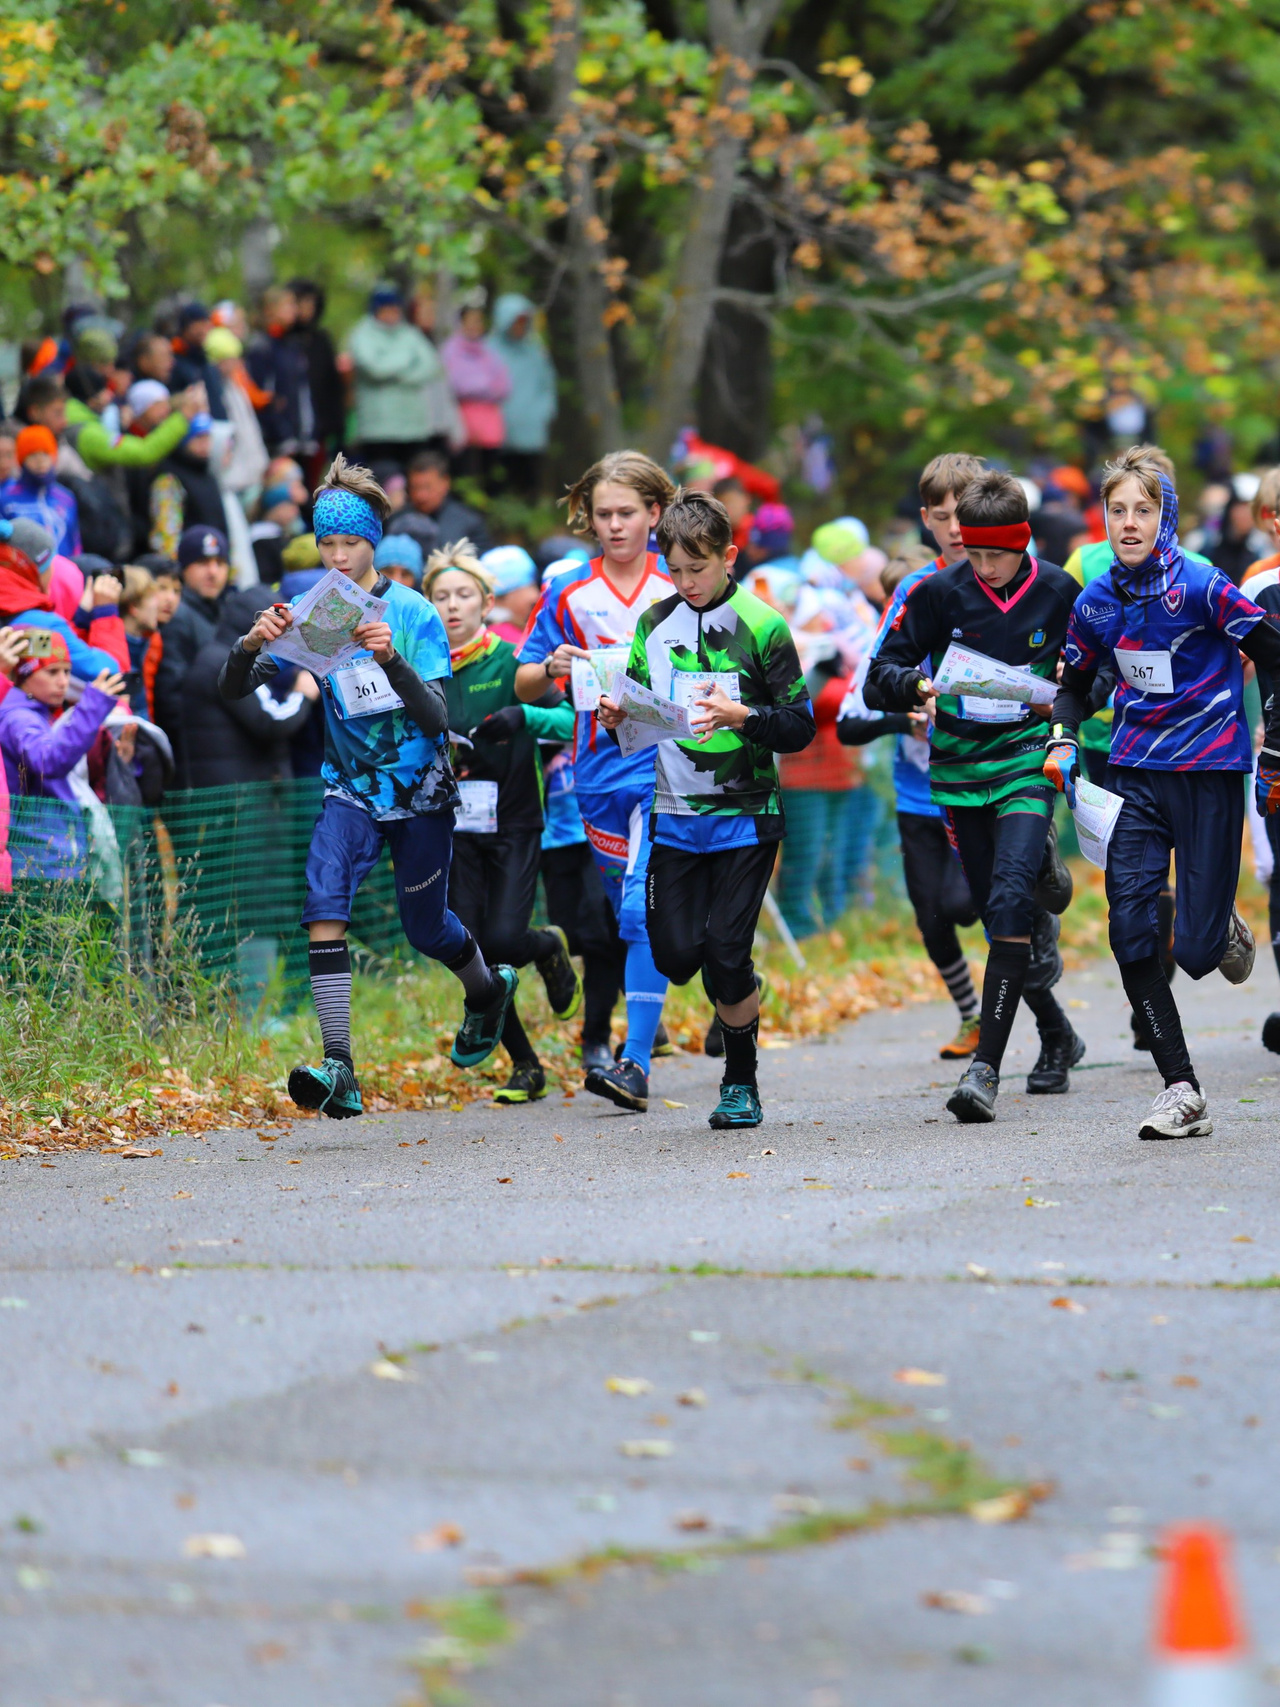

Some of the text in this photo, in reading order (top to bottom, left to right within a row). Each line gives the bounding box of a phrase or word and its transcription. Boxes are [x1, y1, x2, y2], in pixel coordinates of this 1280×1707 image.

[1131, 665, 1154, 680] 267
[355, 681, 378, 699] 261
[405, 868, 442, 893] noname
